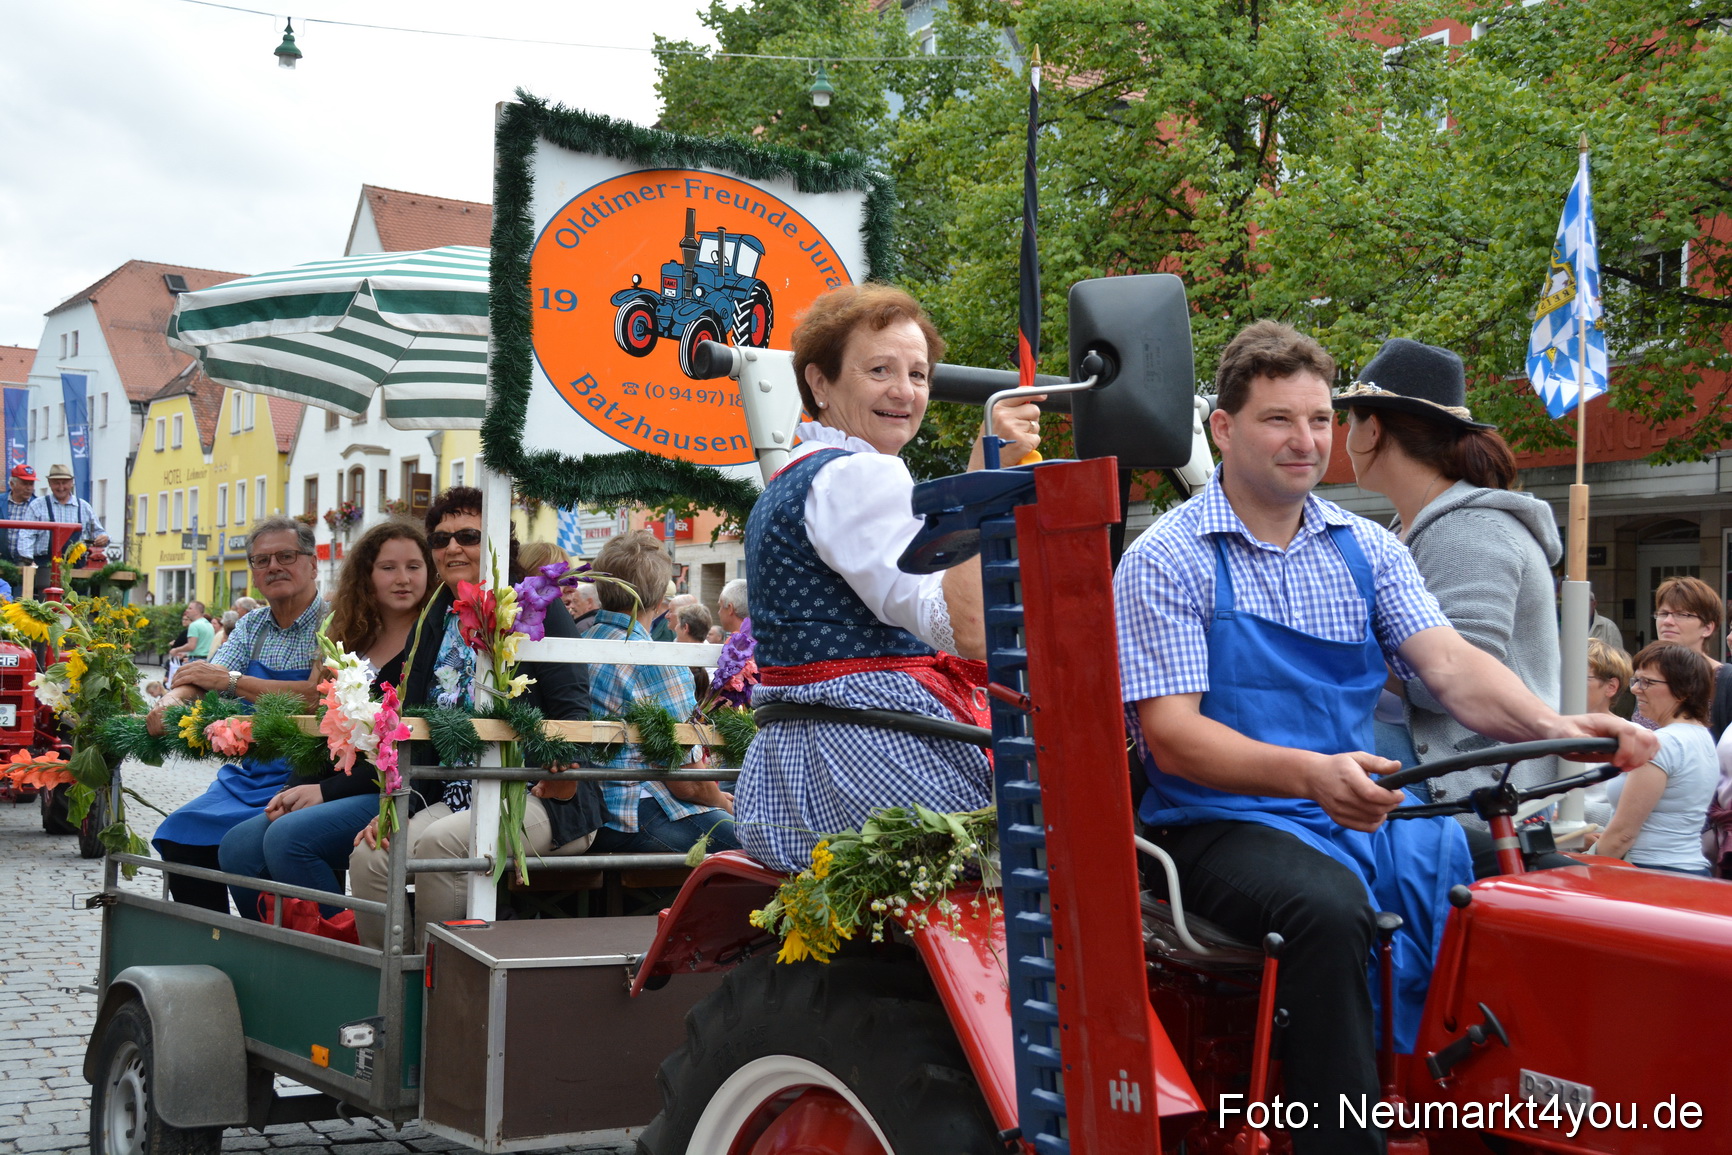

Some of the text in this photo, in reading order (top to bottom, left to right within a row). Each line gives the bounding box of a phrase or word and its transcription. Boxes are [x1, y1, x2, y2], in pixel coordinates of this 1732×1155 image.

[555, 178, 841, 291] Oldtimer-Freunde Jura
[538, 287, 578, 312] 19
[569, 372, 748, 452] Batzhausen
[71, 426, 86, 458] K&L
[164, 468, 182, 485] HOTEL
